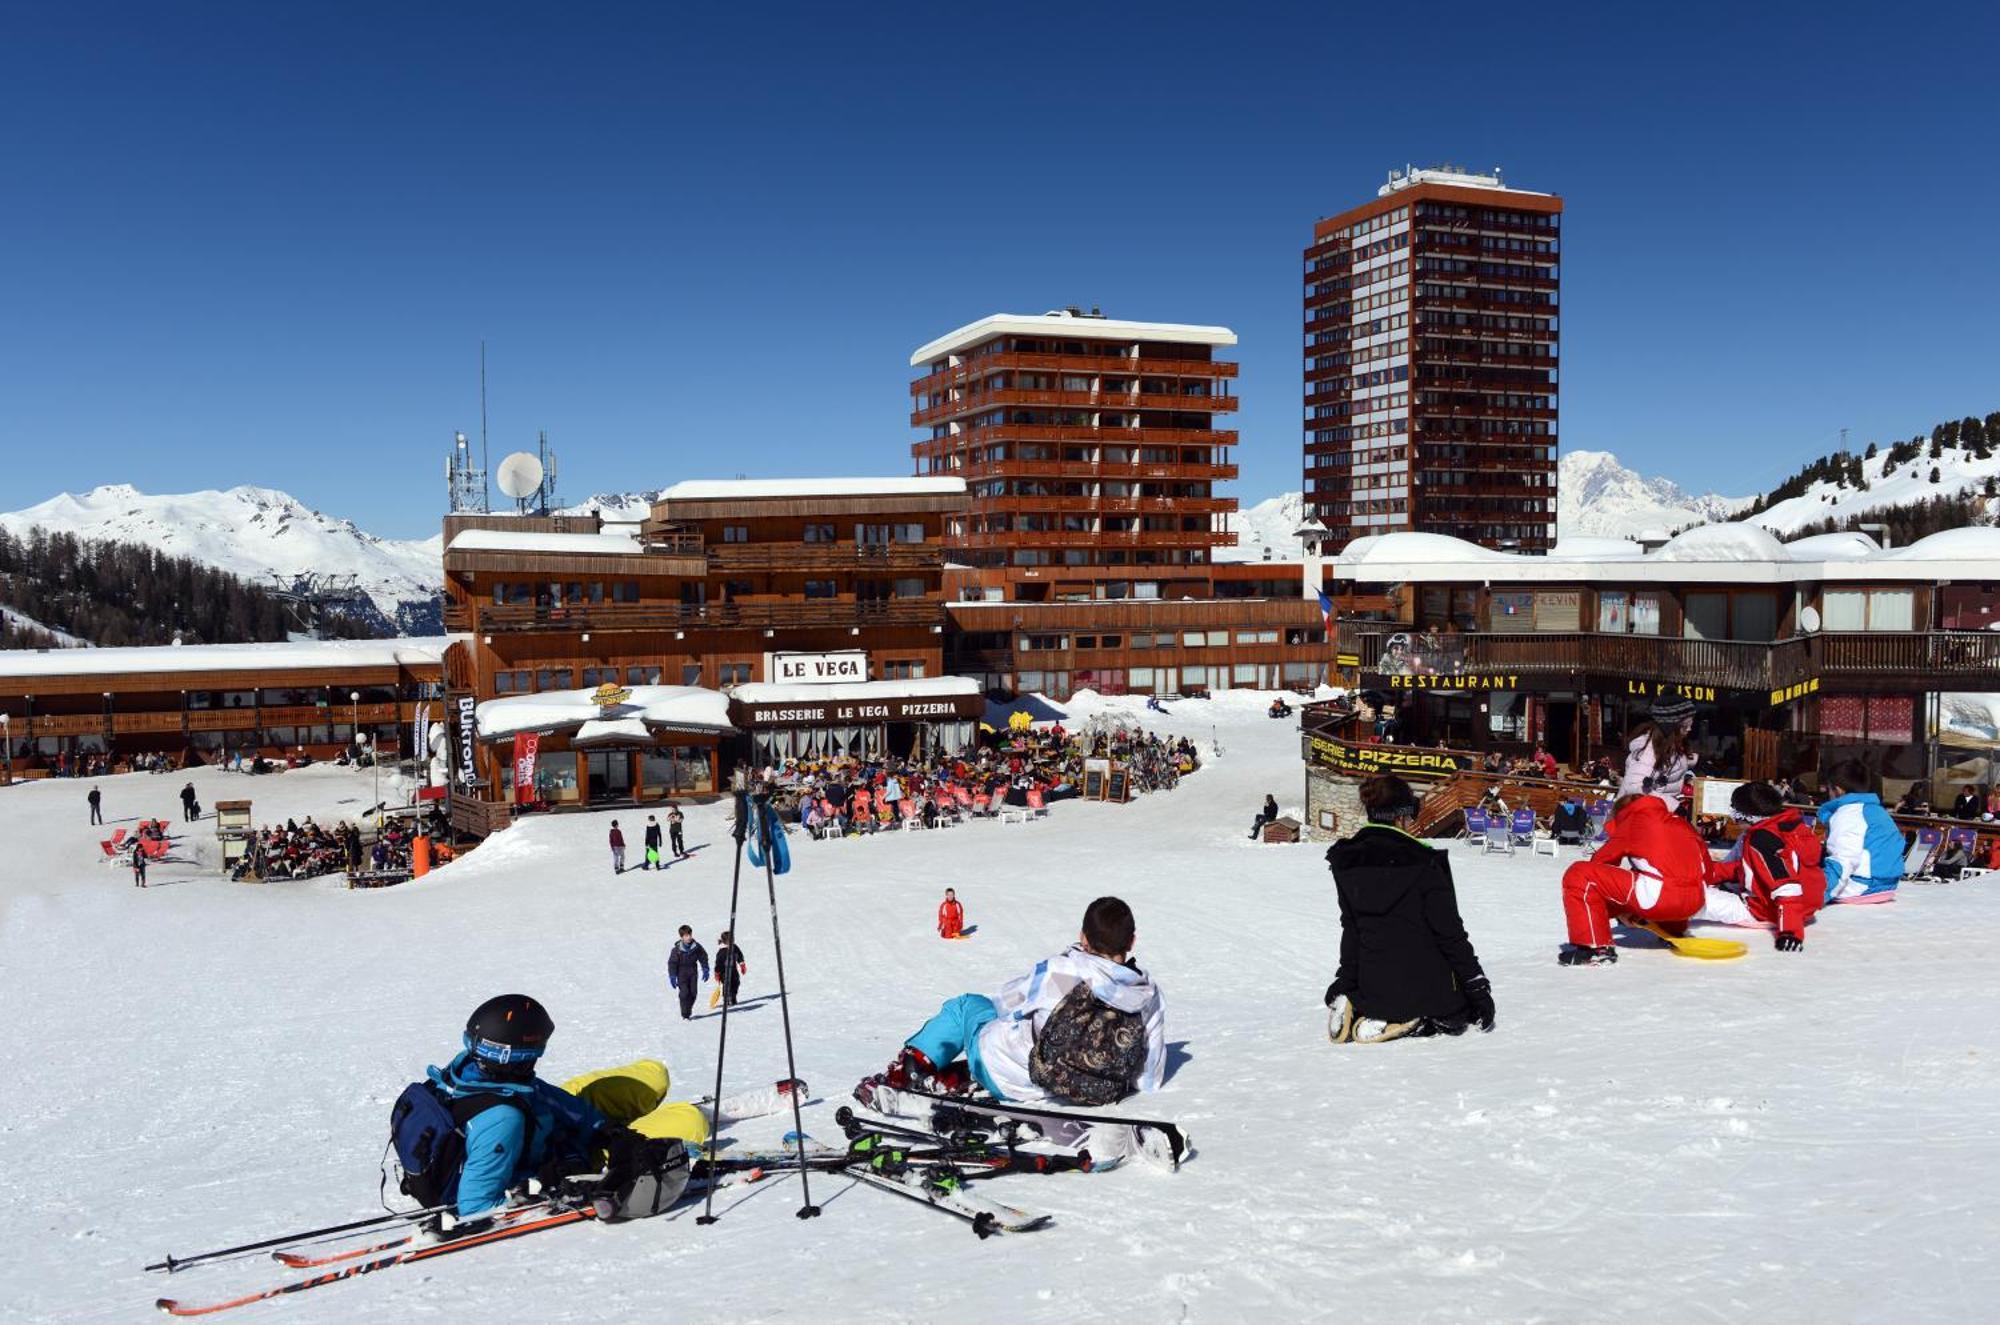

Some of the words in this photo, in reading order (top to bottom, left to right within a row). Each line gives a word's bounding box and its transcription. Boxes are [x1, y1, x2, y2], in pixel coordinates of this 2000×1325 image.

[783, 662, 806, 678] LE
[815, 660, 859, 677] VEGA
[1391, 675, 1518, 689] RESTAURANT
[1628, 680, 1646, 694] LA
[755, 708, 825, 722] BRASSERIE
[837, 707, 854, 719] LE
[858, 705, 889, 717] VEGA
[901, 702, 956, 716] PIZZERIA
[1359, 749, 1458, 770] PIZZERIA
